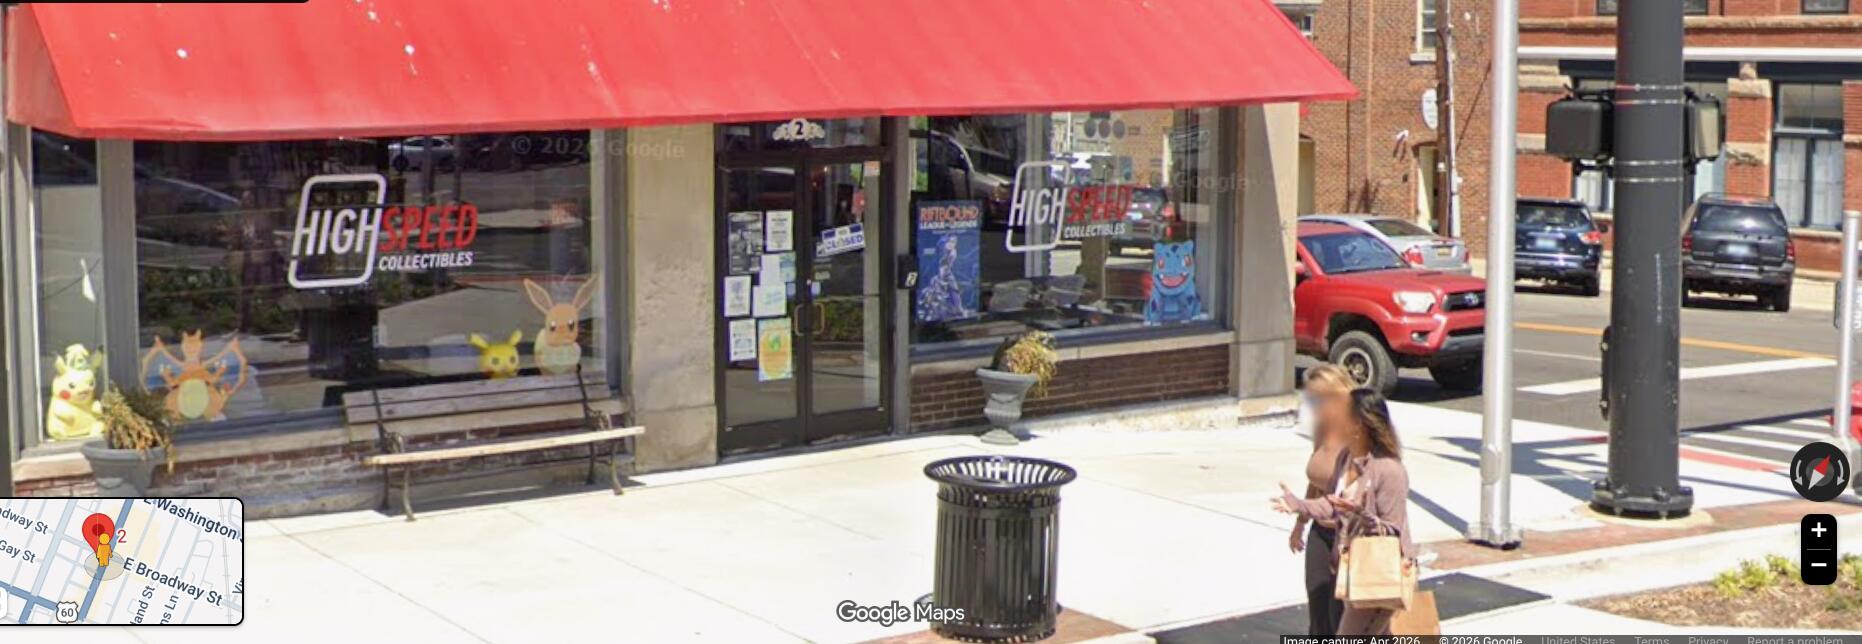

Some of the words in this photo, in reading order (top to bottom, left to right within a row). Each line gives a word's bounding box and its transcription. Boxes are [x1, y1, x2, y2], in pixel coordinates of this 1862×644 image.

[795, 121, 804, 135] 2
[1064, 222, 1126, 239] COLLECTIBLES
[826, 233, 864, 250] CLOSED
[378, 251, 473, 271] COLLECTIBLES
